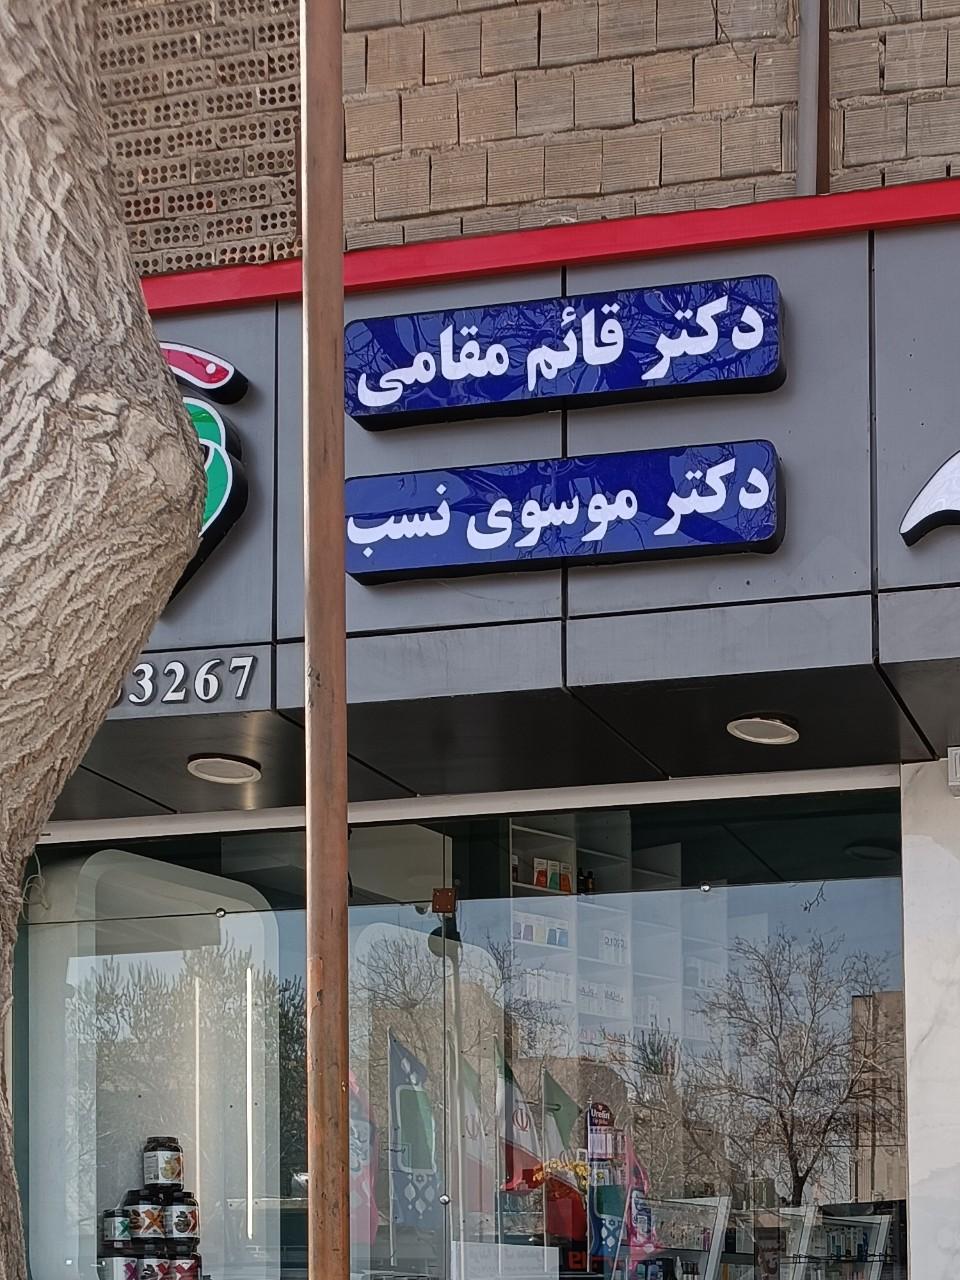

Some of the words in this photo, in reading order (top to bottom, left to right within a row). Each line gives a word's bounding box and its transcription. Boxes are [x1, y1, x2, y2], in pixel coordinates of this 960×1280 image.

[357, 324, 510, 407] مقامی
[526, 303, 624, 392] قائم
[641, 295, 764, 380] دکتر
[346, 484, 451, 557] نسب
[466, 489, 638, 550] موسوی
[653, 458, 770, 536] دکتر
[111, 656, 255, 704] 3267
